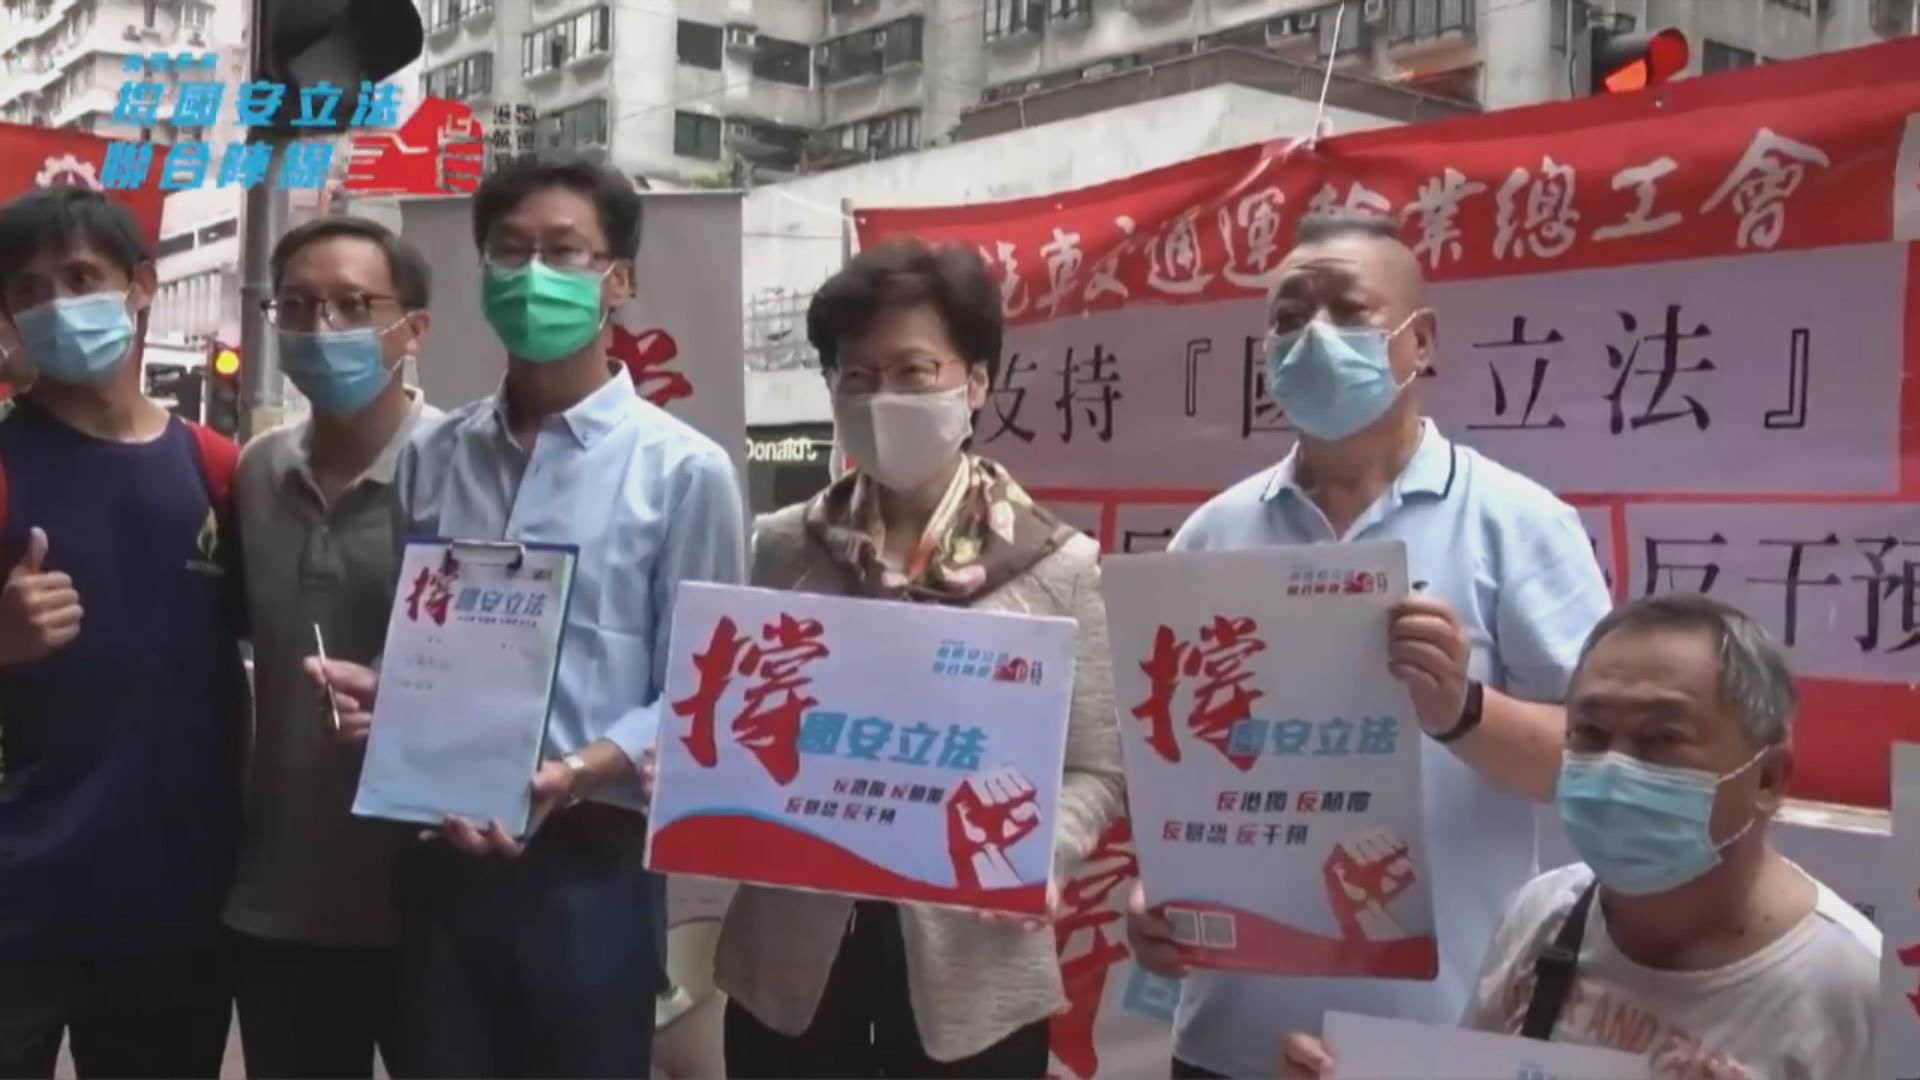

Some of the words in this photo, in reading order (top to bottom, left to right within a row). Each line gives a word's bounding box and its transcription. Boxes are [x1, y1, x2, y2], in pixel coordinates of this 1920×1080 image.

[672, 612, 830, 786] 撐
[800, 711, 988, 771] 國安立法
[1131, 615, 1267, 773] 撐
[1227, 716, 1399, 758] 國安立法
